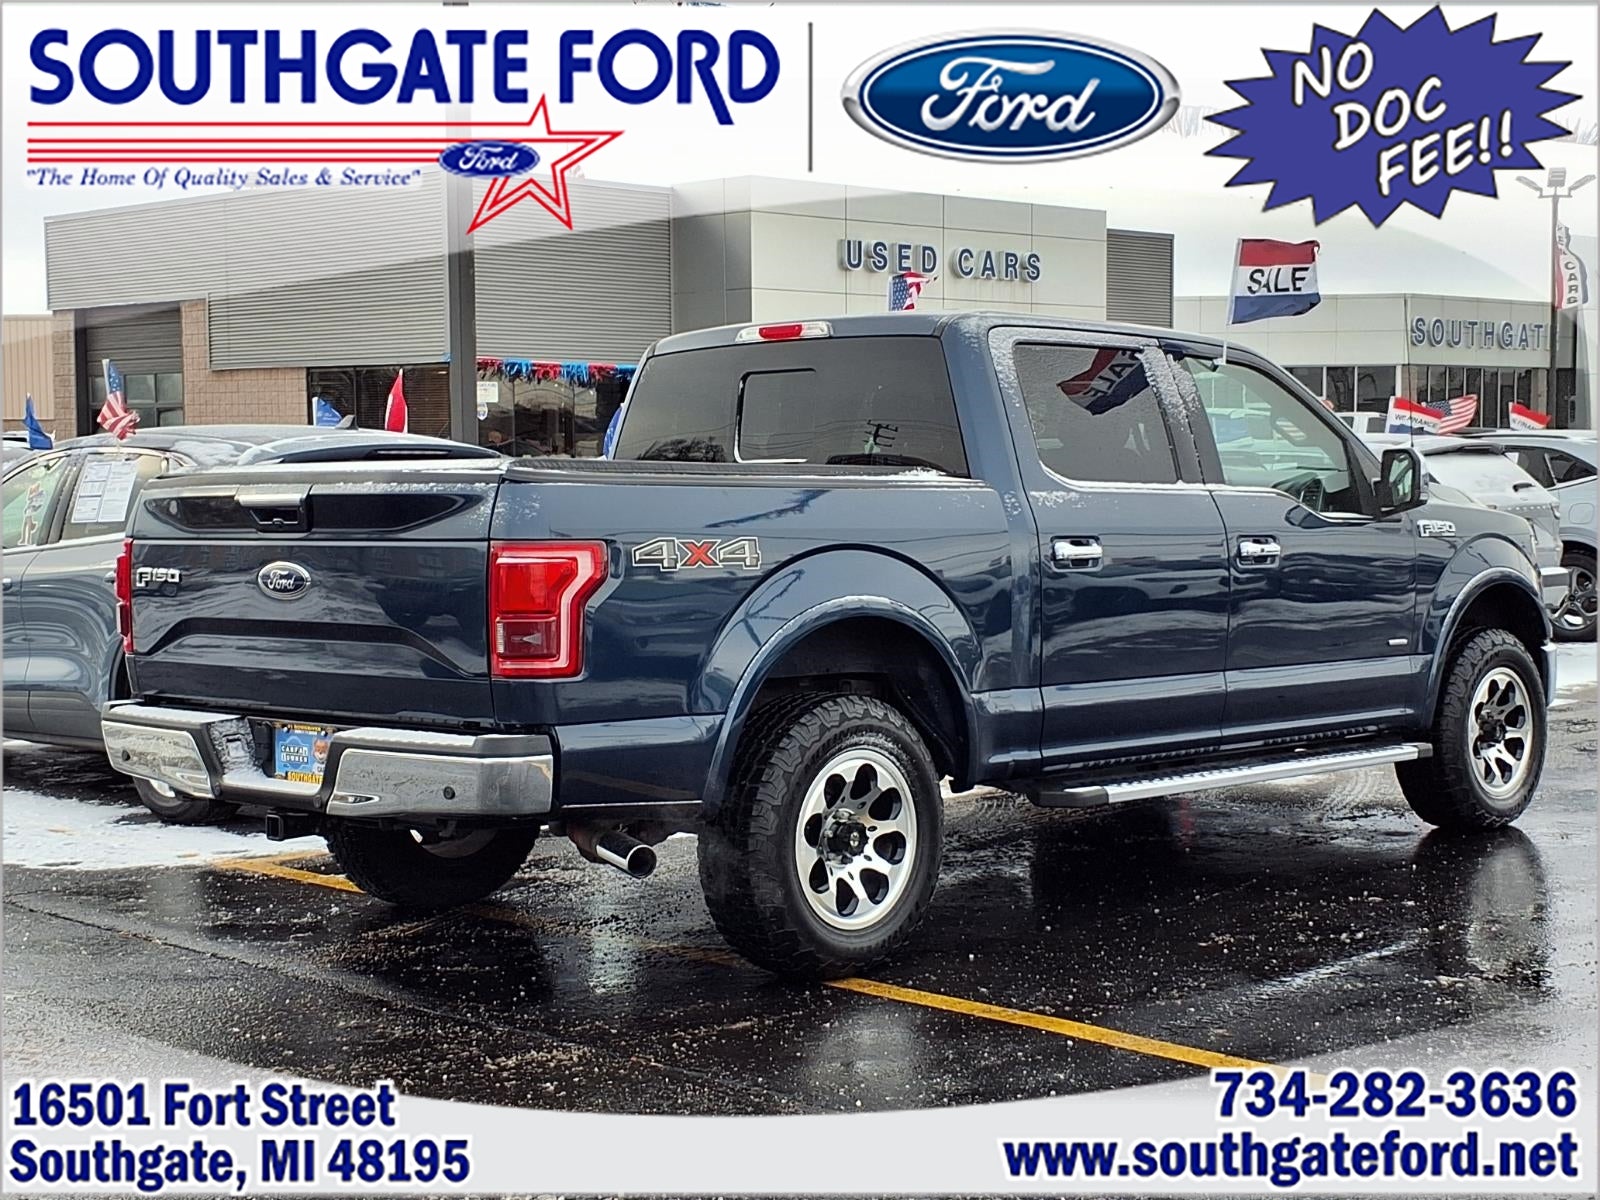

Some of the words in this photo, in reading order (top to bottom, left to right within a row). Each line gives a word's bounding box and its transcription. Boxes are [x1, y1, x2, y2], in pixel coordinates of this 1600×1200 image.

[839, 239, 938, 274] USED
[952, 248, 1041, 283] CARS
[1247, 266, 1311, 295] SALE
[1411, 316, 1549, 350] SOUTHGAT
[267, 570, 296, 590] Ford
